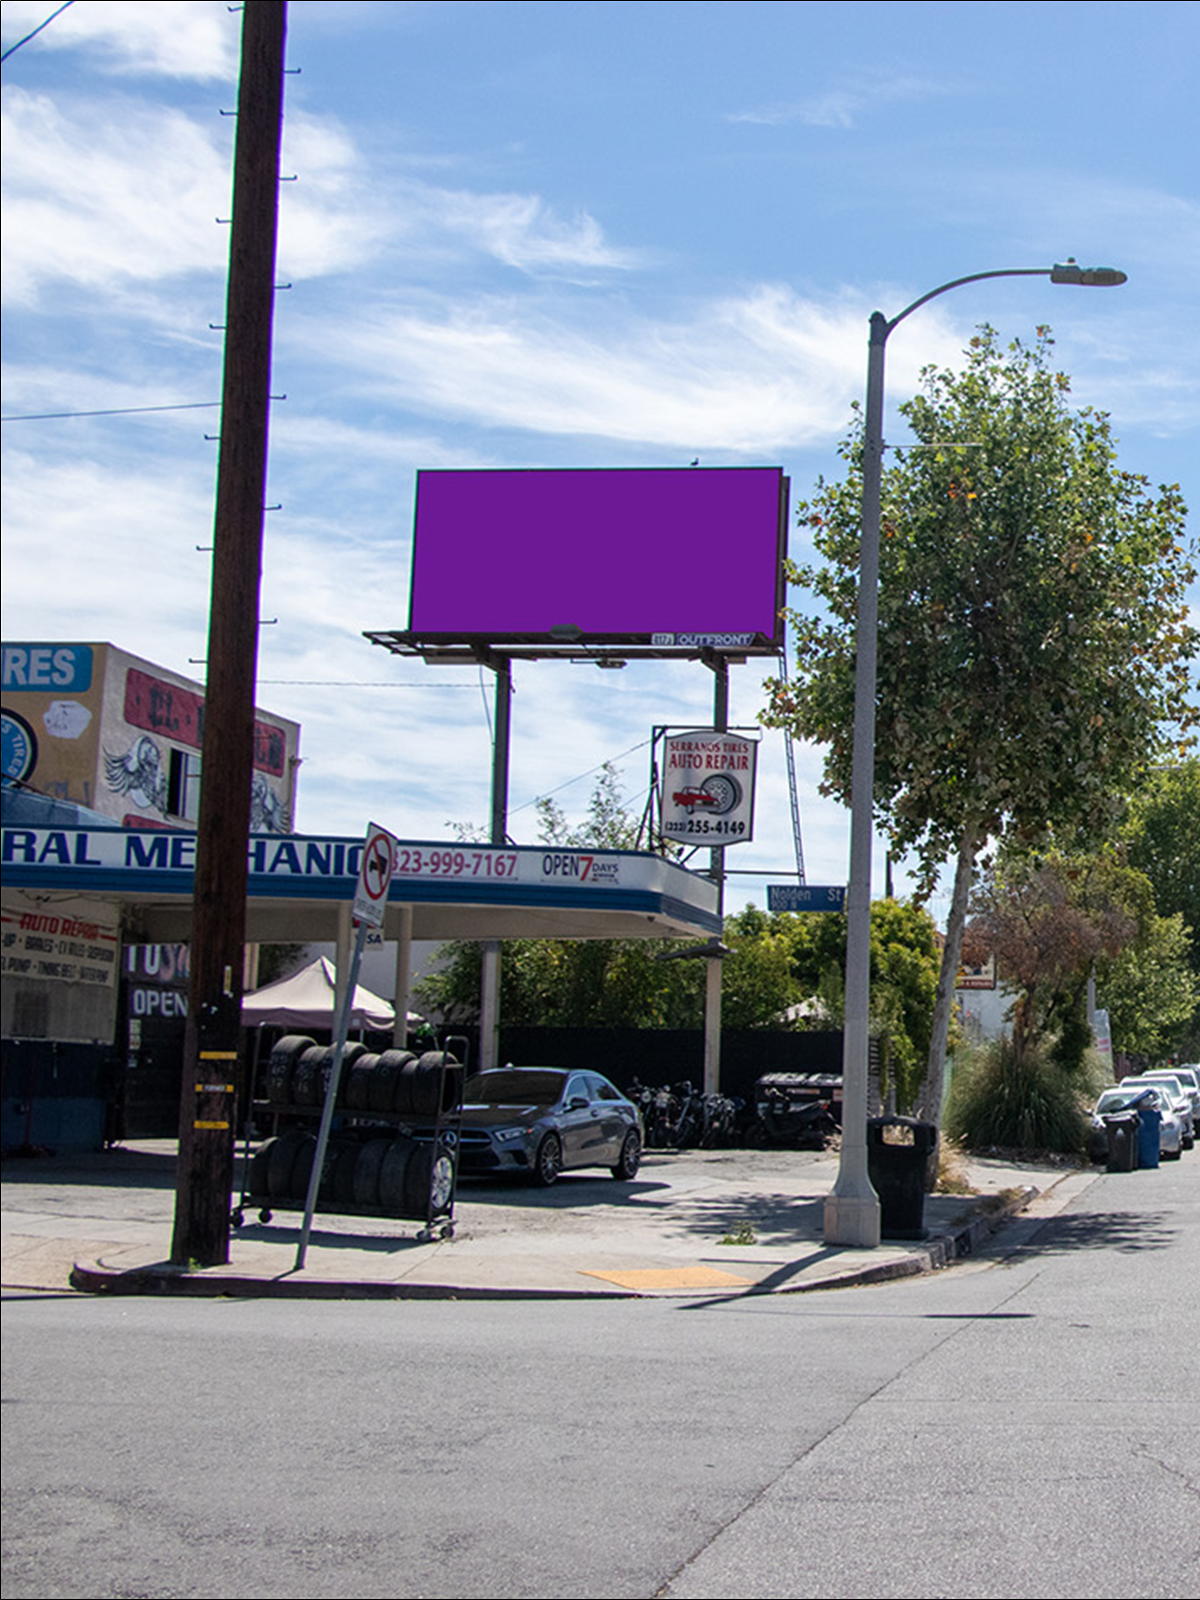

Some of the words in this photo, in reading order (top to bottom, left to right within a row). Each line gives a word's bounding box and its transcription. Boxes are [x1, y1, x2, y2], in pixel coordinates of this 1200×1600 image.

[680, 634, 750, 645] OUTFRONT
[1, 648, 76, 685] RES
[7, 735, 25, 775] TIRES
[723, 743, 749, 753] TIRES
[669, 754, 703, 769] AUTO
[705, 755, 749, 770] REPAIR
[687, 820, 746, 835] 255-4149
[1, 830, 101, 864] RAL
[124, 835, 365, 876] MEHANIC
[542, 854, 579, 876] OPEN
[579, 855, 594, 881] 7
[592, 863, 619, 873] DAYS
[771, 887, 811, 900] Nolden
[827, 888, 841, 901] St
[20, 913, 60, 934] AUTO
[133, 989, 189, 1017] OPEN
